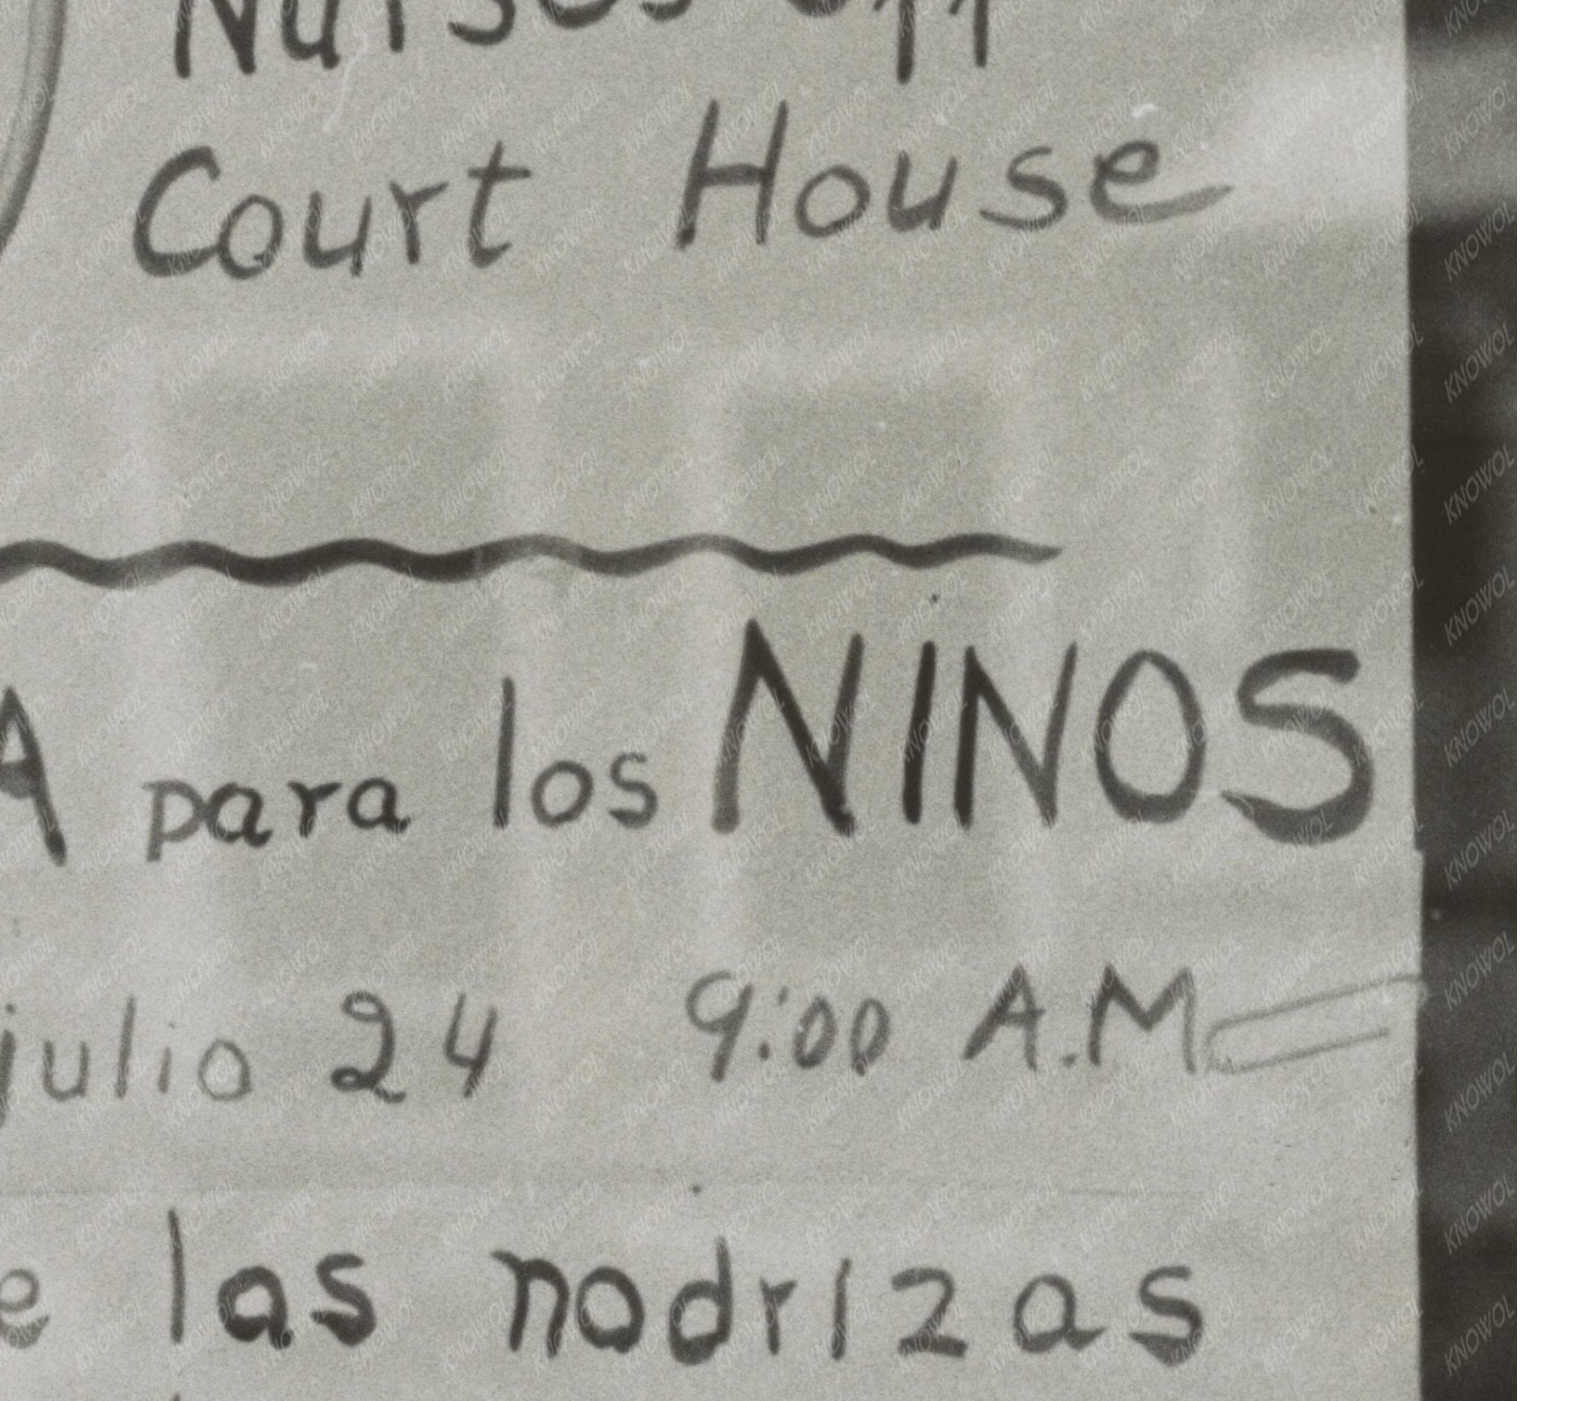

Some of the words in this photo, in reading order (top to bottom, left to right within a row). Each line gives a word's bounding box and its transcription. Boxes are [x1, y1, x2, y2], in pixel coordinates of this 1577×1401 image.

[130, 141, 533, 283] Court
[673, 99, 1231, 252] House
[146, 775, 411, 863] para
[488, 675, 662, 832] los
[712, 617, 1375, 845] NINOS
[327, 991, 500, 1106] 24
[683, 970, 893, 1085] 9:00
[166, 1211, 378, 1351] las
[492, 1241, 1206, 1368] nodrizas
